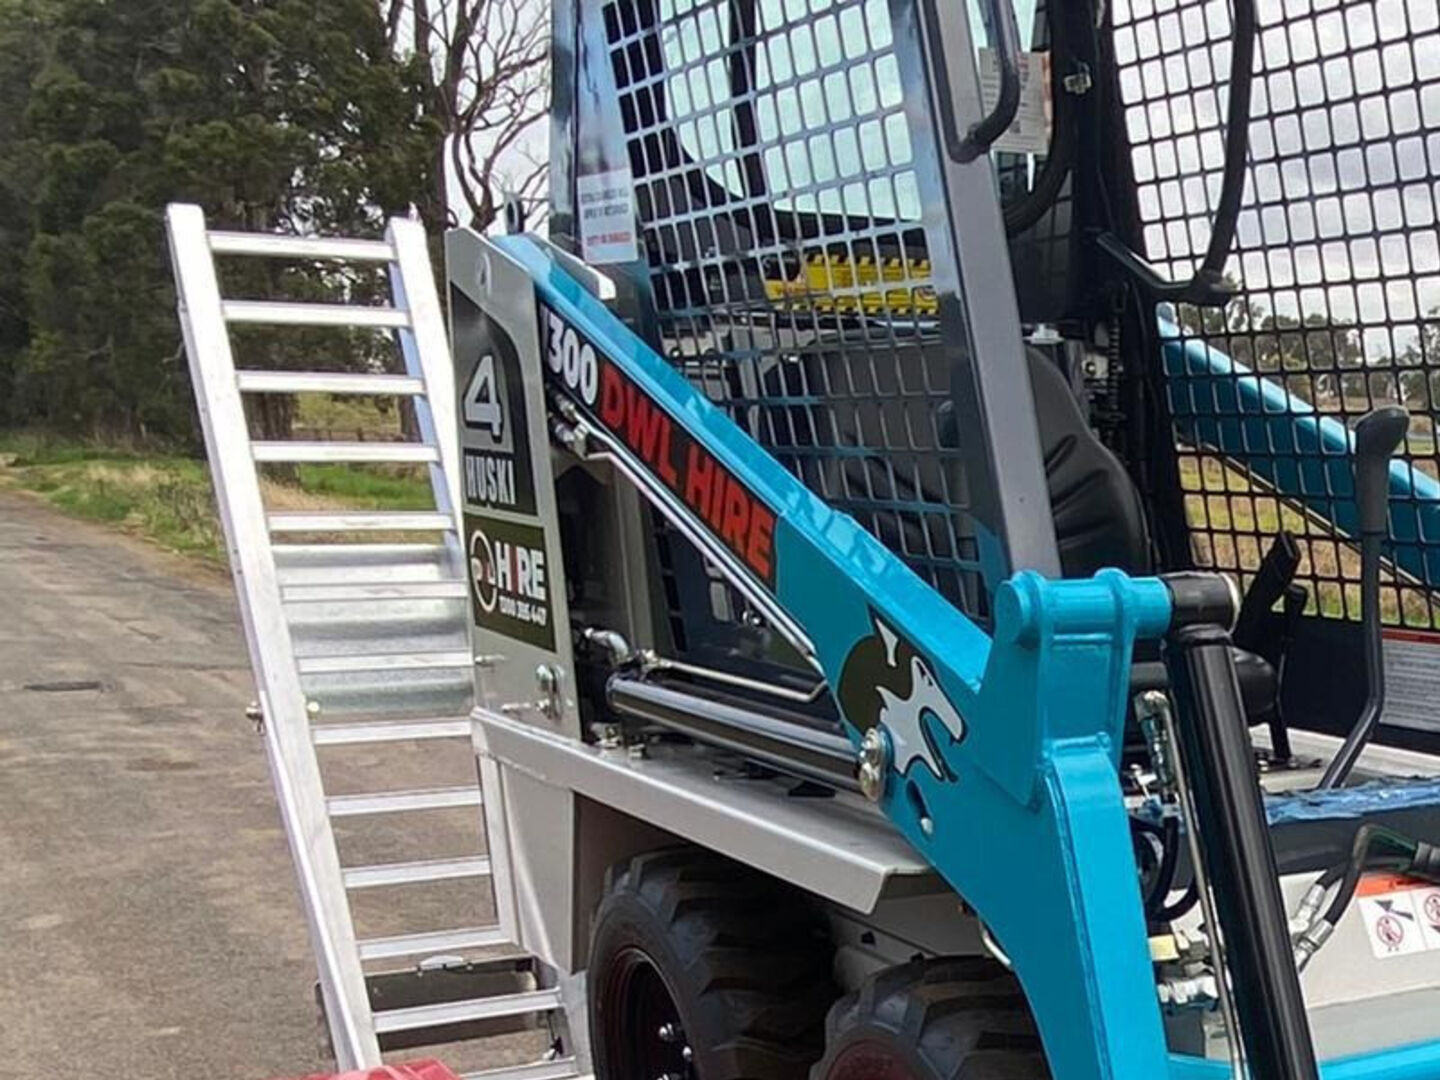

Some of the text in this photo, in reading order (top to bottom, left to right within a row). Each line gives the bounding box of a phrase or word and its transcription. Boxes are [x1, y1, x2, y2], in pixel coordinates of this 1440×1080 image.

[463, 354, 502, 440] 4
[464, 454, 517, 505] HUSKI
[602, 361, 677, 488] DWL
[684, 443, 776, 579] HIRE
[494, 540, 547, 601] HIRE
